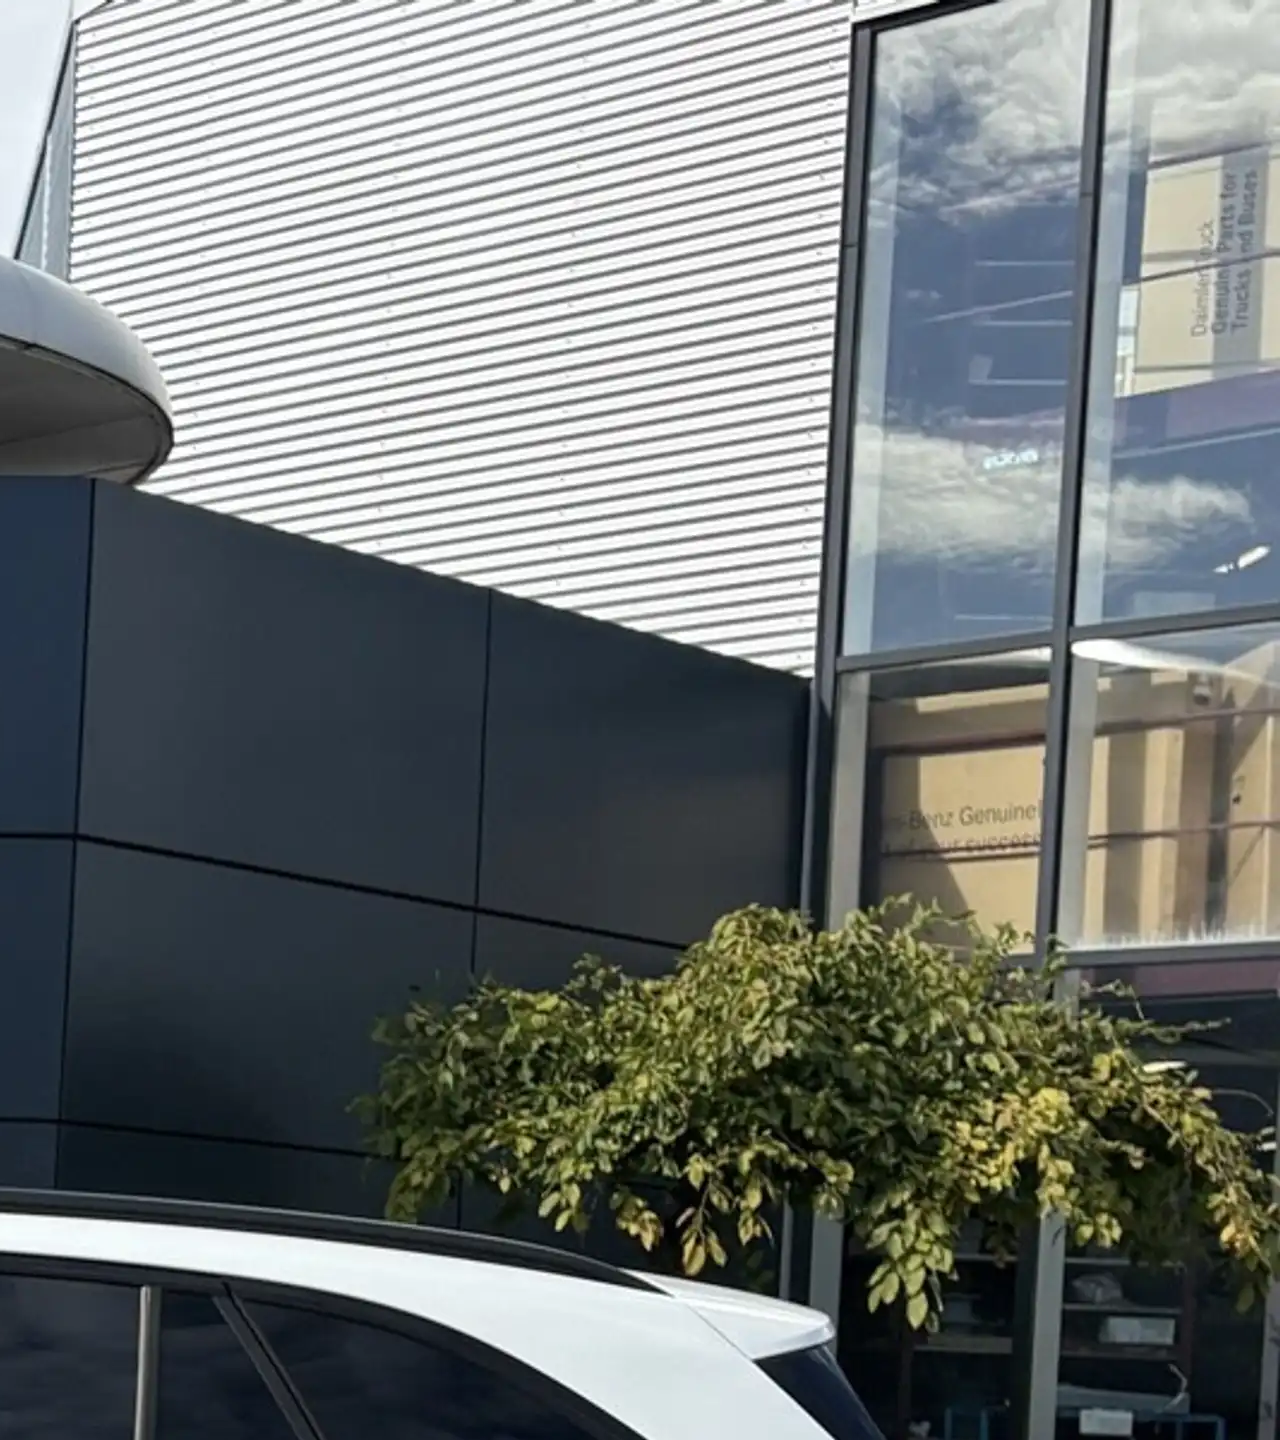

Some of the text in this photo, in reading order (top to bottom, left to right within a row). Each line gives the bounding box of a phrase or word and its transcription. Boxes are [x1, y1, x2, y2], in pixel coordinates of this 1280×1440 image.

[1215, 203, 1236, 253] Parts
[1211, 267, 1230, 335] Genuin
[1229, 268, 1252, 336] Trucks
